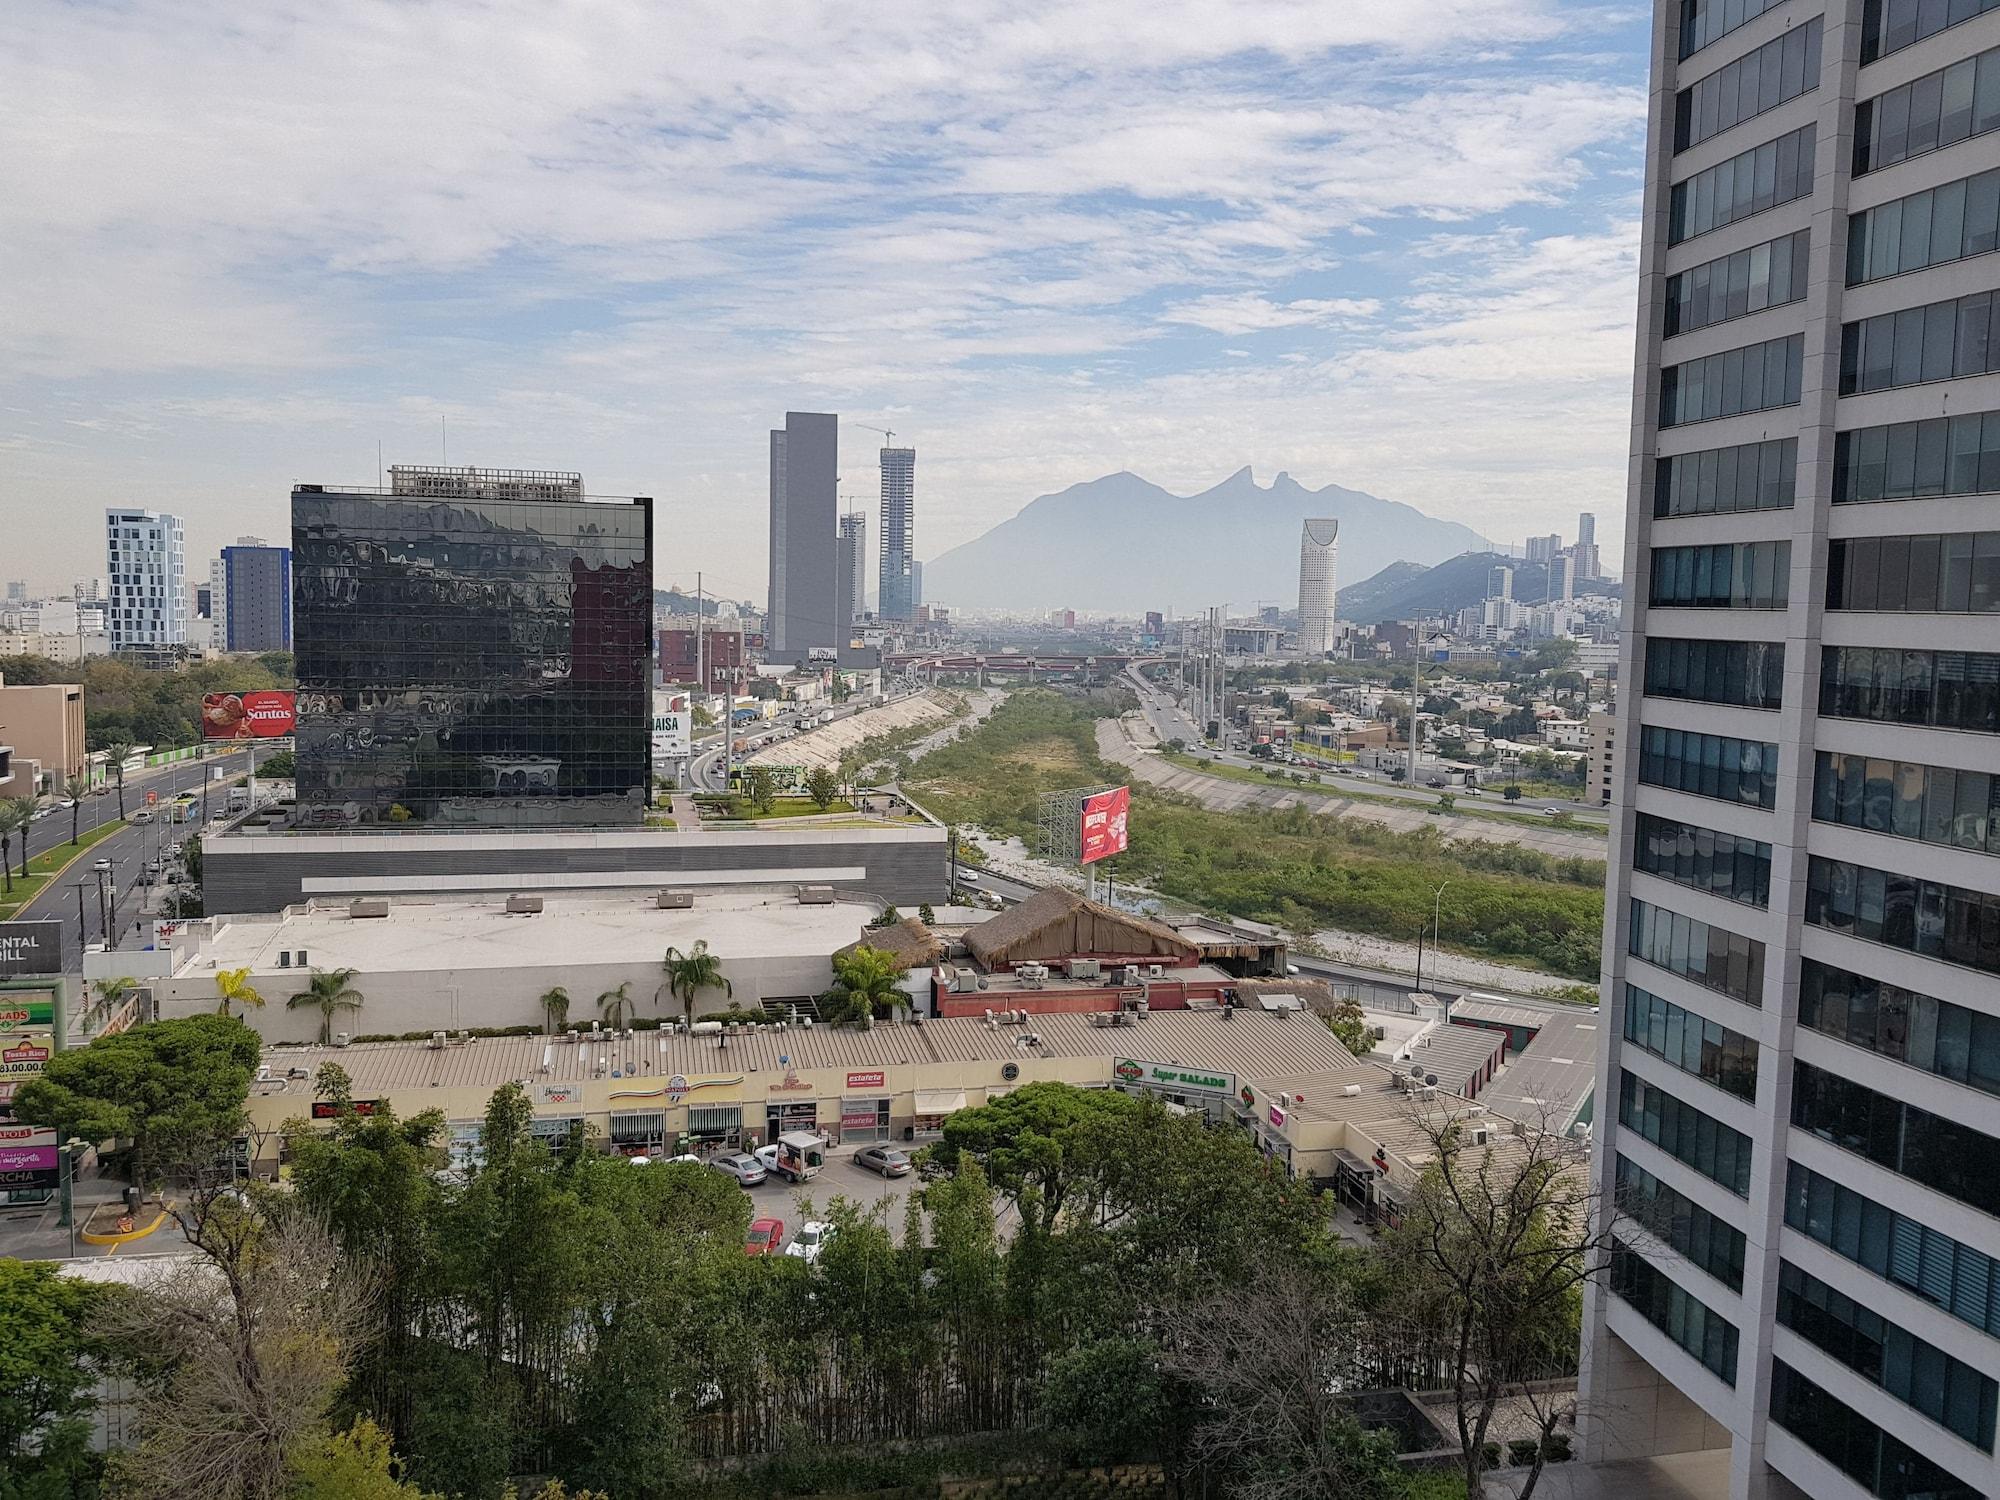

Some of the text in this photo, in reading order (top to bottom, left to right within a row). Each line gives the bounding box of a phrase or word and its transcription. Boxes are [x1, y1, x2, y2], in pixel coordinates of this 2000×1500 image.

[246, 708, 292, 720] Santas
[848, 1074, 882, 1082] estafeta
[1151, 1067, 1227, 1088] Super SALADS
